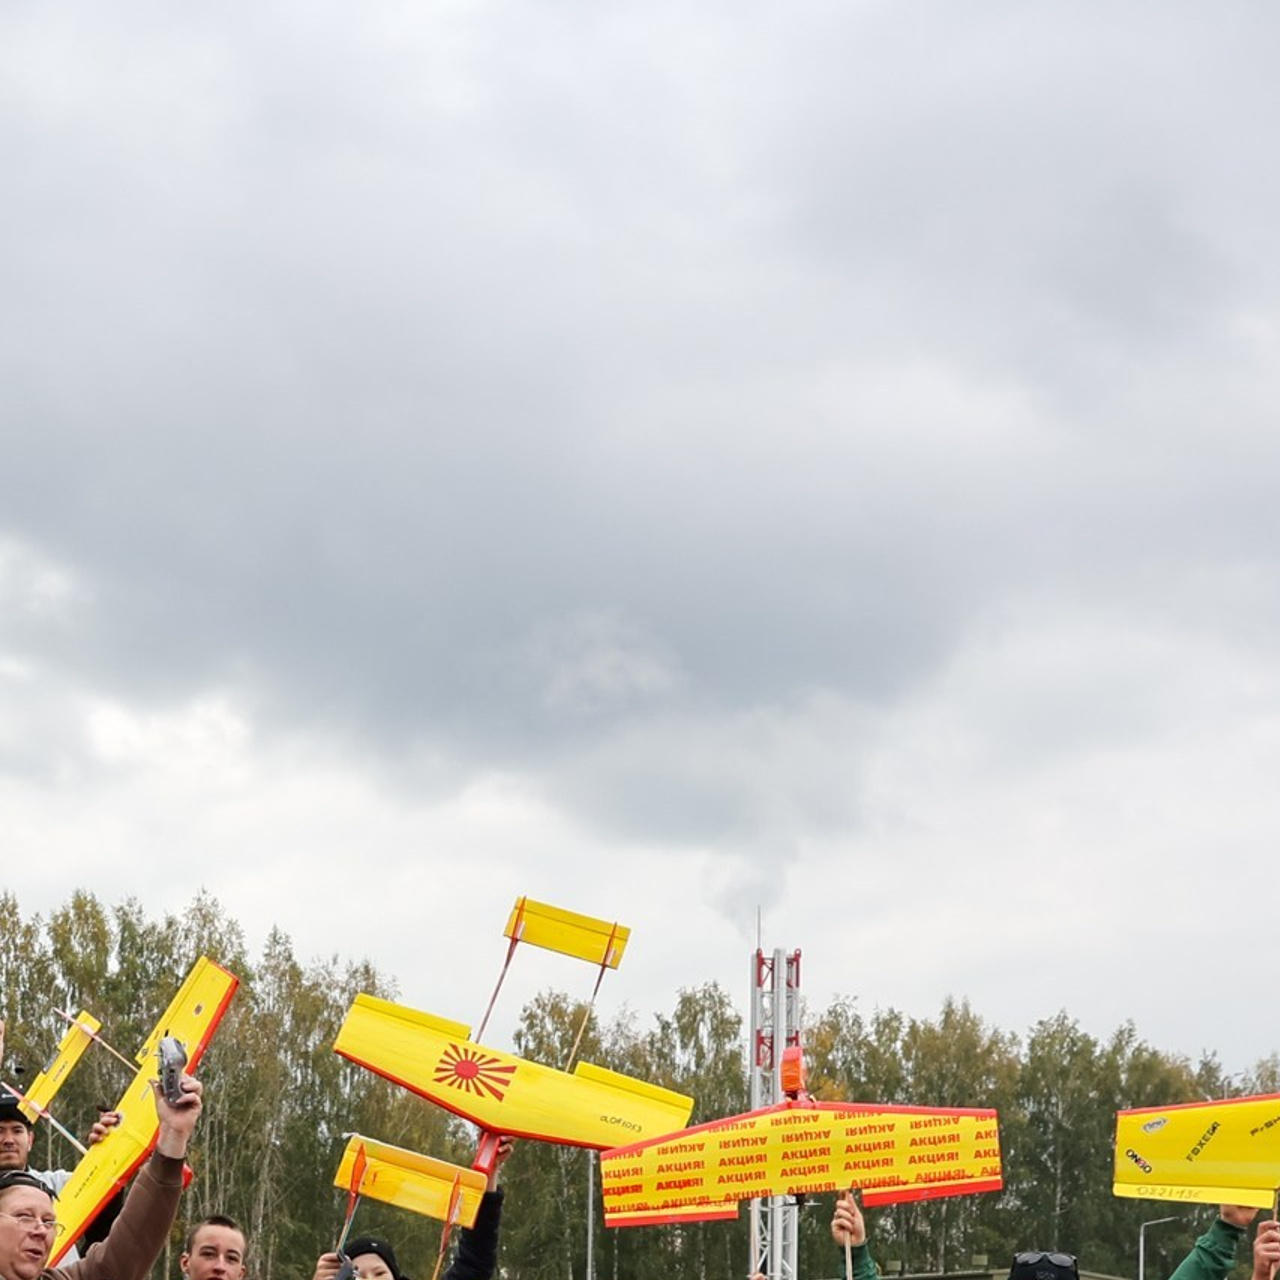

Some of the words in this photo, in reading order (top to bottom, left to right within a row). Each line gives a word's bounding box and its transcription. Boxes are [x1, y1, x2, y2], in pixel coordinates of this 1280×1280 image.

[846, 1124, 895, 1136] АКЦИЯ!
[782, 1130, 831, 1143] АКЦИЯ!
[657, 1143, 705, 1155] АКЦИЯ!
[719, 1137, 767, 1149] АКЦИЯ!
[604, 1167, 643, 1179] КЦИЯ!
[657, 1161, 704, 1173] АКЦИЯ!
[719, 1154, 767, 1167] АКЦИЯ!
[781, 1147, 831, 1160] АКЦИЯ!
[845, 1140, 895, 1153] АКЦИЯ!
[910, 1134, 960, 1147] АКЦИЯ!
[603, 1184, 642, 1196] КЦИЯ!
[656, 1178, 703, 1190] АКЦИЯ!
[718, 1171, 766, 1184] АКЦИЯ!
[780, 1164, 829, 1177] АКЦИЯ!
[844, 1158, 894, 1170] АКЦИЯ!
[908, 1151, 959, 1164] АКЦИЯ!
